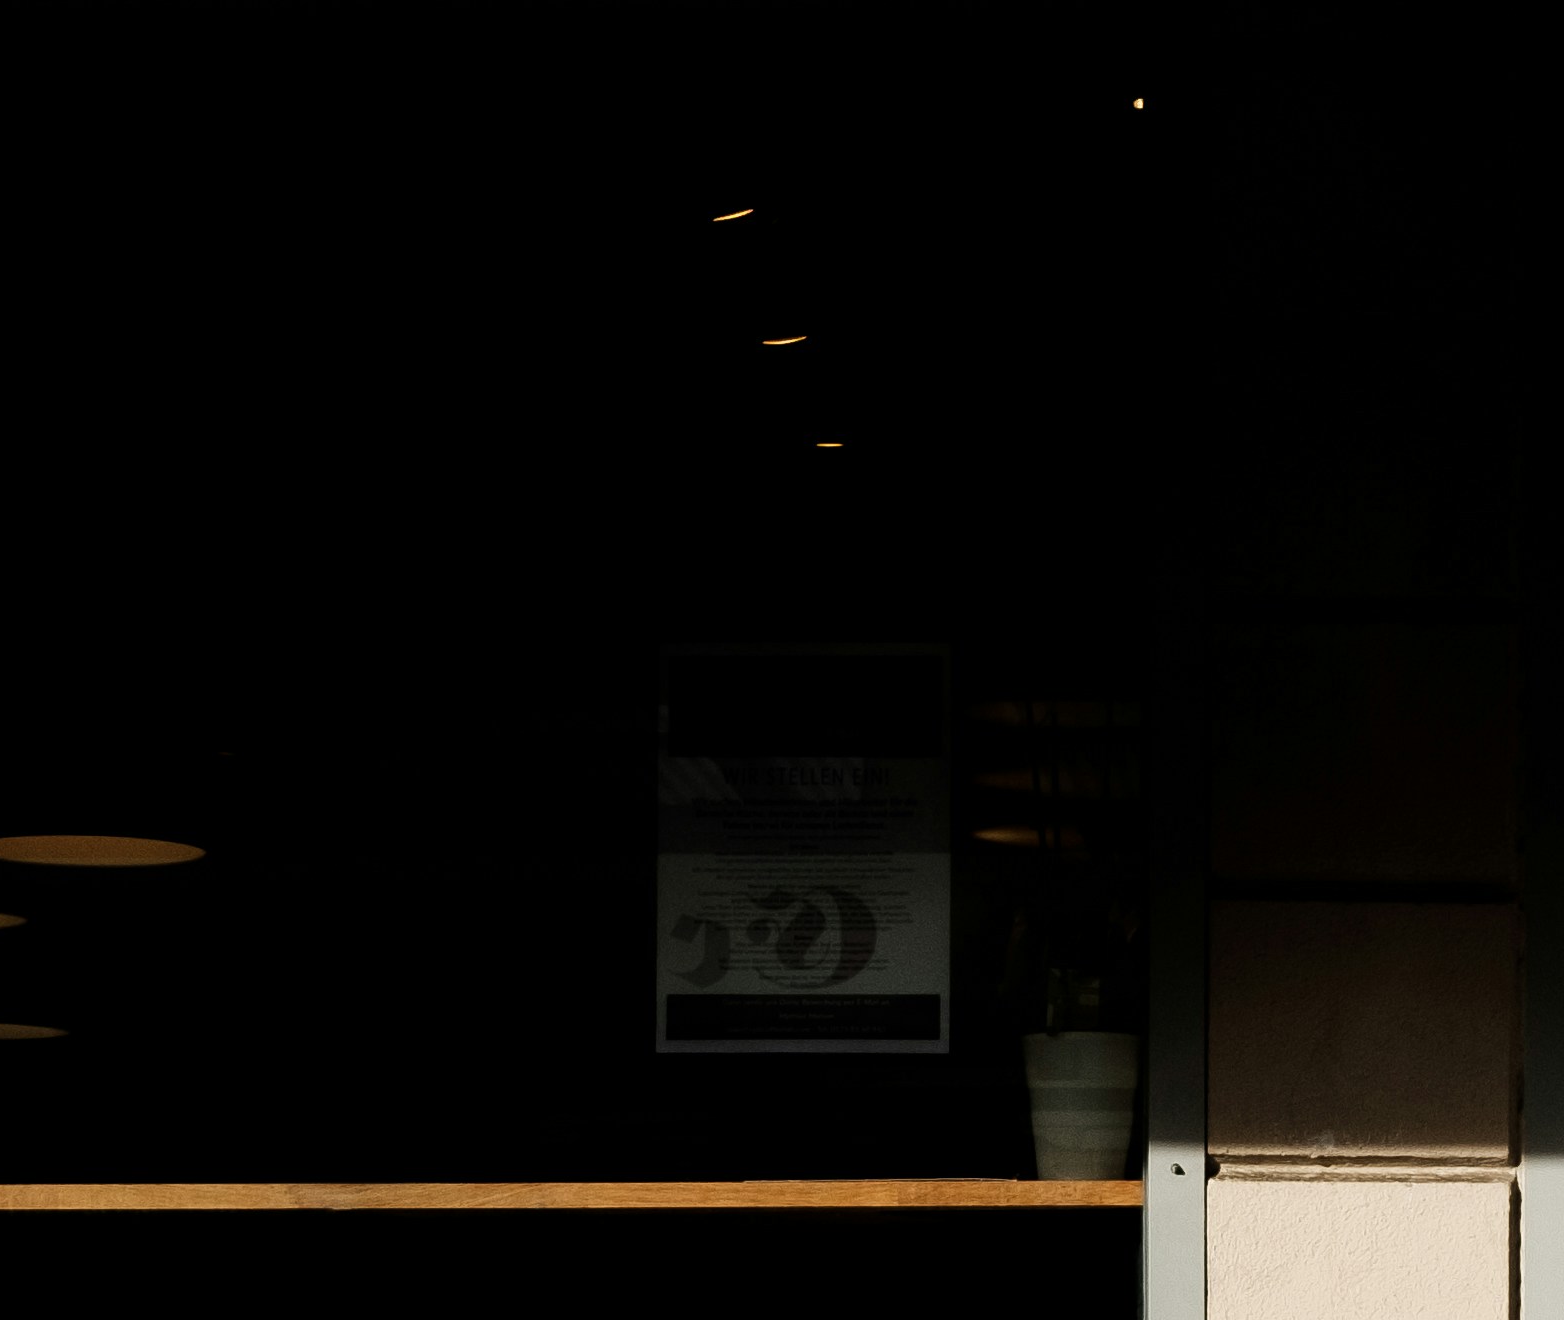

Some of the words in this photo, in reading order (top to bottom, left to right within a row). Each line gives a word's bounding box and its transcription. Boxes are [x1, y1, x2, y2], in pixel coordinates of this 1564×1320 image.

[723, 767, 759, 786] WIR
[766, 767, 844, 786] STELLEN
[852, 767, 890, 786] EIN!
